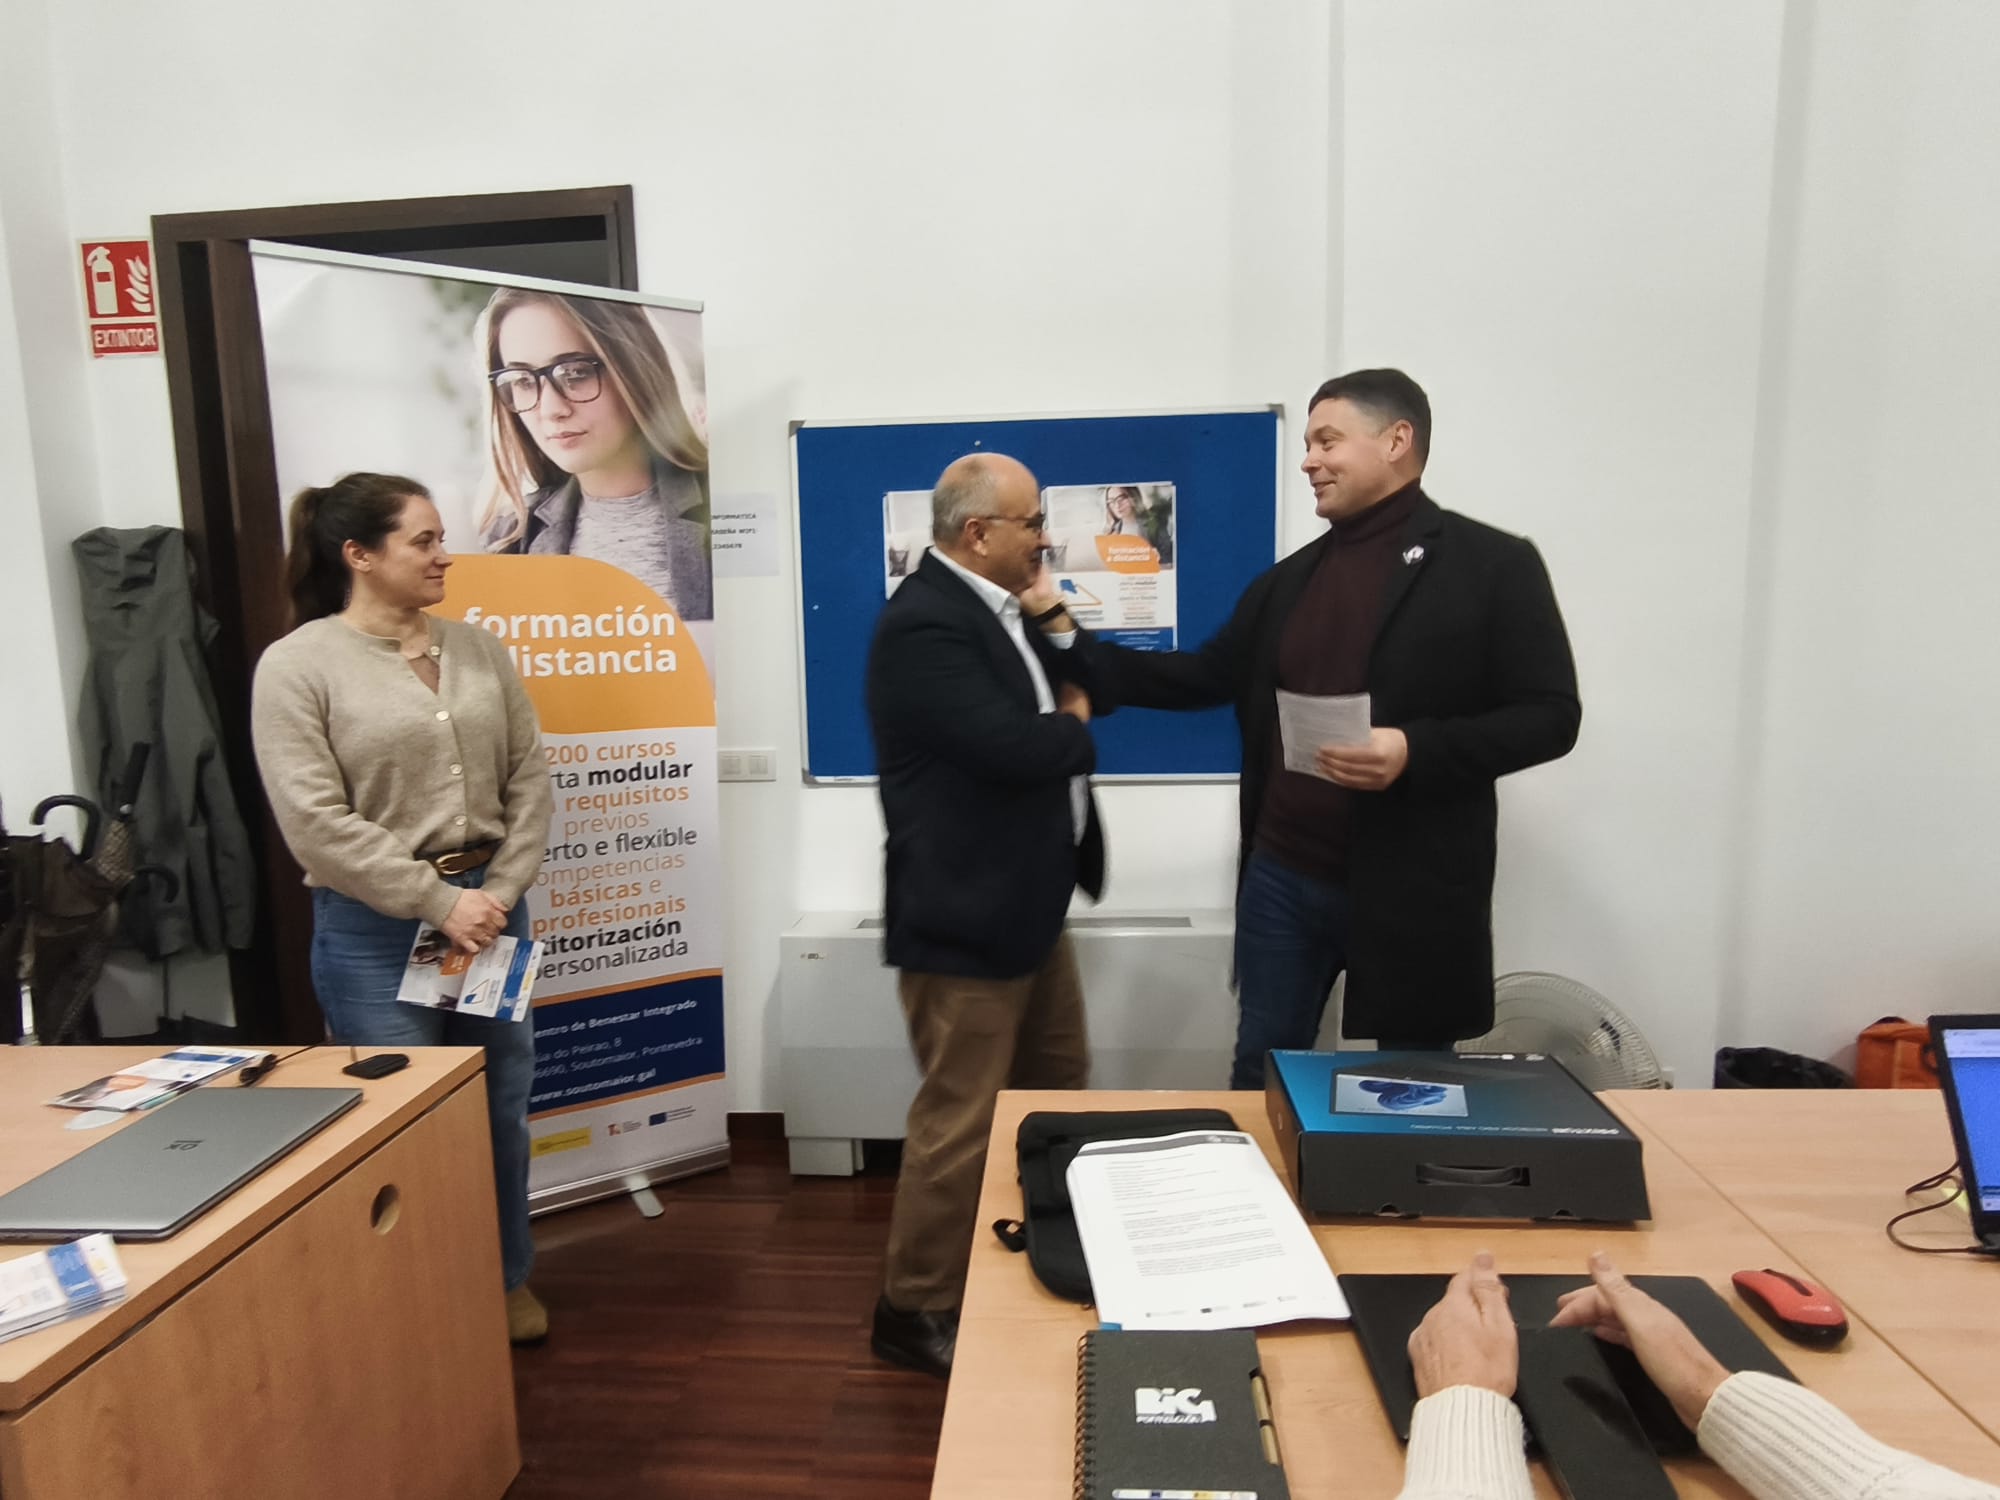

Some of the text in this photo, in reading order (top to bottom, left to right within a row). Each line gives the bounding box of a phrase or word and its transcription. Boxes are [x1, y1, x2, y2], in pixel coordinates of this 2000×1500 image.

[94, 328, 156, 348] EXTINTOR
[464, 605, 675, 639] formación
[544, 741, 676, 766] 200 cursos
[588, 760, 693, 786] modular
[565, 785, 689, 815] requisitos
[564, 811, 649, 841] previos
[594, 841, 609, 856] e
[616, 826, 697, 853] flexible
[550, 878, 662, 908] básicas e
[532, 895, 687, 939] profesionais
[571, 1021, 586, 1032] de
[588, 1011, 641, 1028] Benestar
[643, 999, 697, 1016] Integrado
[553, 1049, 569, 1059] do
[642, 1036, 703, 1056] Pontevedra
